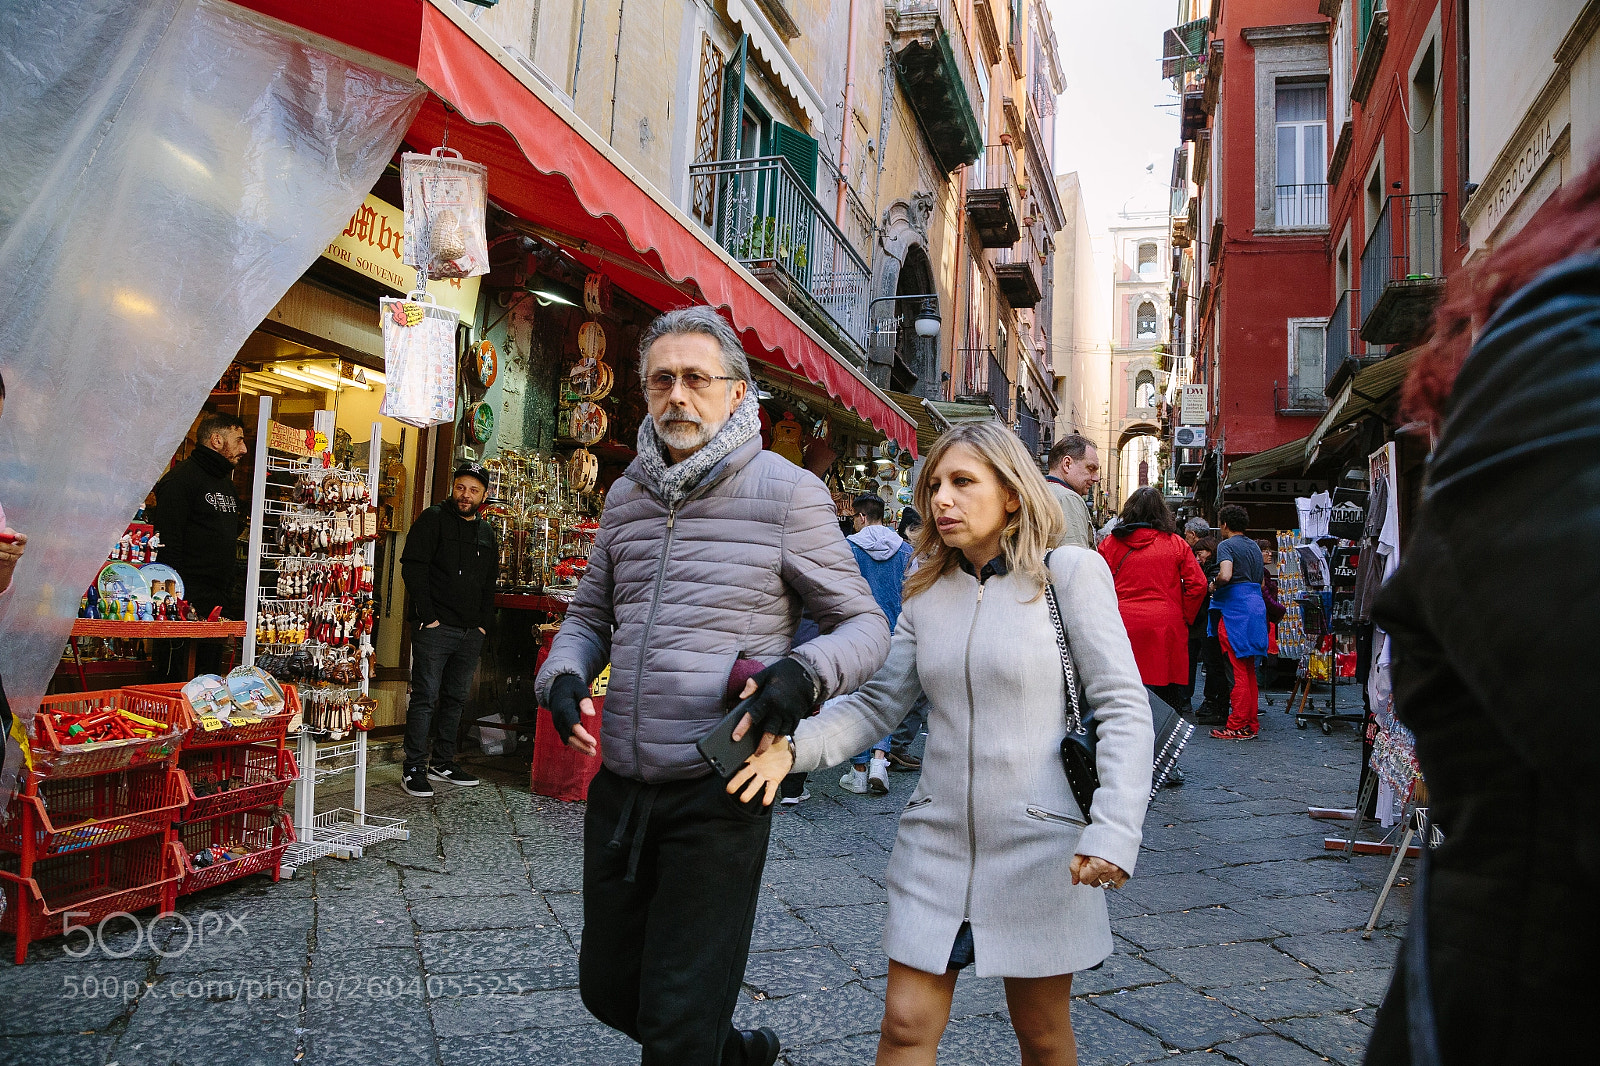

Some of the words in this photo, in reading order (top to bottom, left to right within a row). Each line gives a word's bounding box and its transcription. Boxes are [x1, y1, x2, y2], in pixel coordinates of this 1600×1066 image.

[1487, 119, 1552, 228] PARROCCHIA
[324, 243, 352, 263] TORI
[355, 256, 404, 287] SOUVENIR
[1186, 387, 1204, 395] DM
[1330, 510, 1364, 524] NAPOLI
[1334, 567, 1357, 577] NAPO
